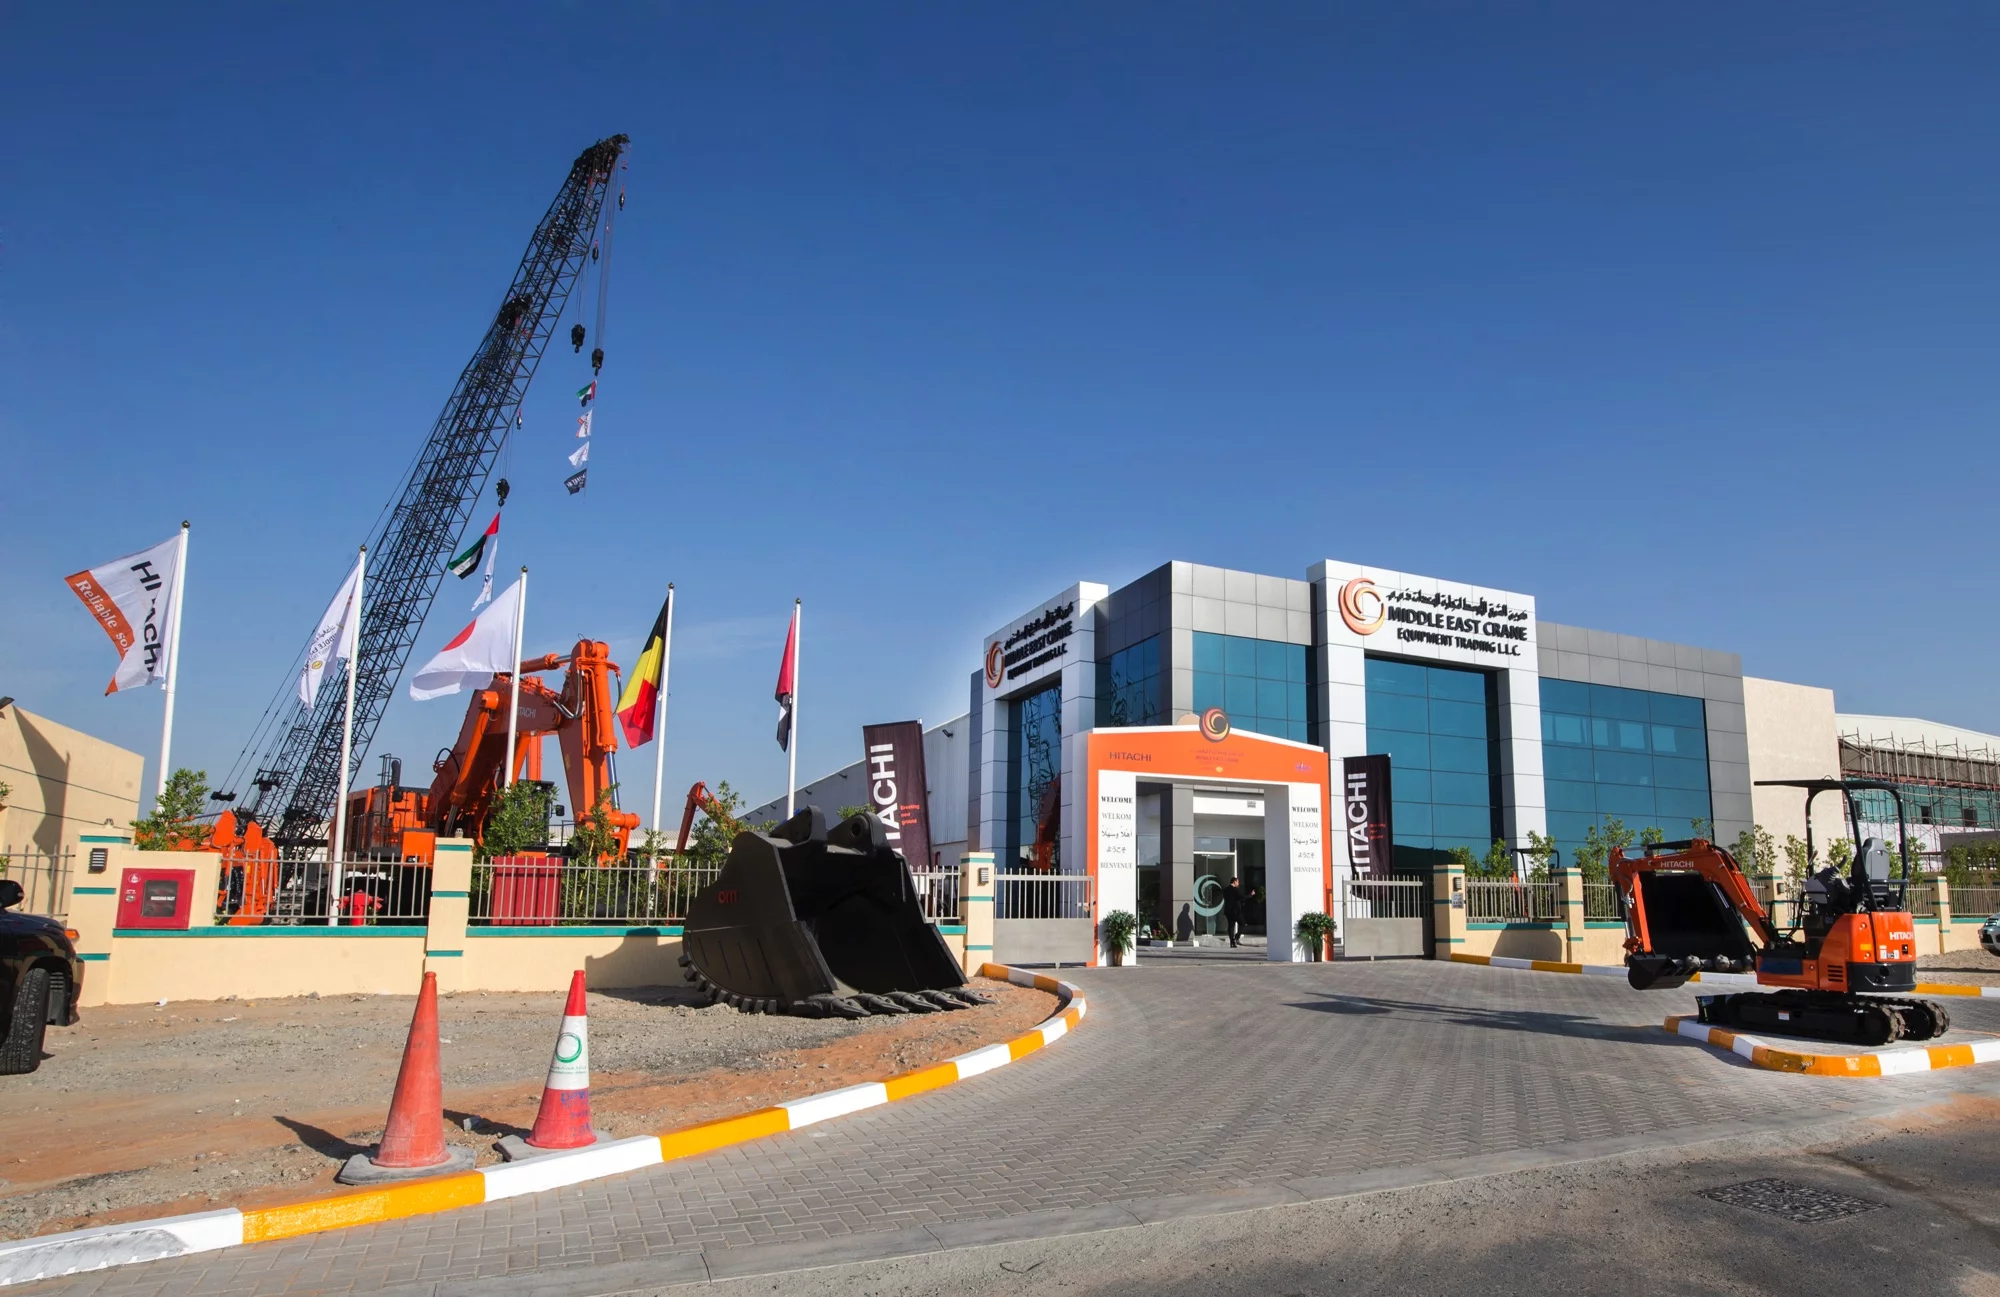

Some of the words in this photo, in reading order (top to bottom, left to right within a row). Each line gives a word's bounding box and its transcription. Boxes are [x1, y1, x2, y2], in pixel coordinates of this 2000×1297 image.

[75, 579, 118, 629] Reliable
[131, 560, 163, 674] HIACH
[1387, 605, 1444, 629] MIDDLE
[1446, 615, 1481, 634] EAST
[1482, 621, 1528, 641] CRANE
[1397, 627, 1454, 647] EQUIPMENT
[1454, 636, 1496, 653] TRADING
[518, 706, 537, 718] TACHI
[1109, 751, 1152, 762] HITACHI
[1101, 796, 1133, 804] WELCOME
[1102, 812, 1132, 820] WELKOM
[1100, 861, 1133, 869] BIENVENUE
[1660, 860, 1694, 868] HITACHI
[1889, 931, 1914, 941] HITACH
